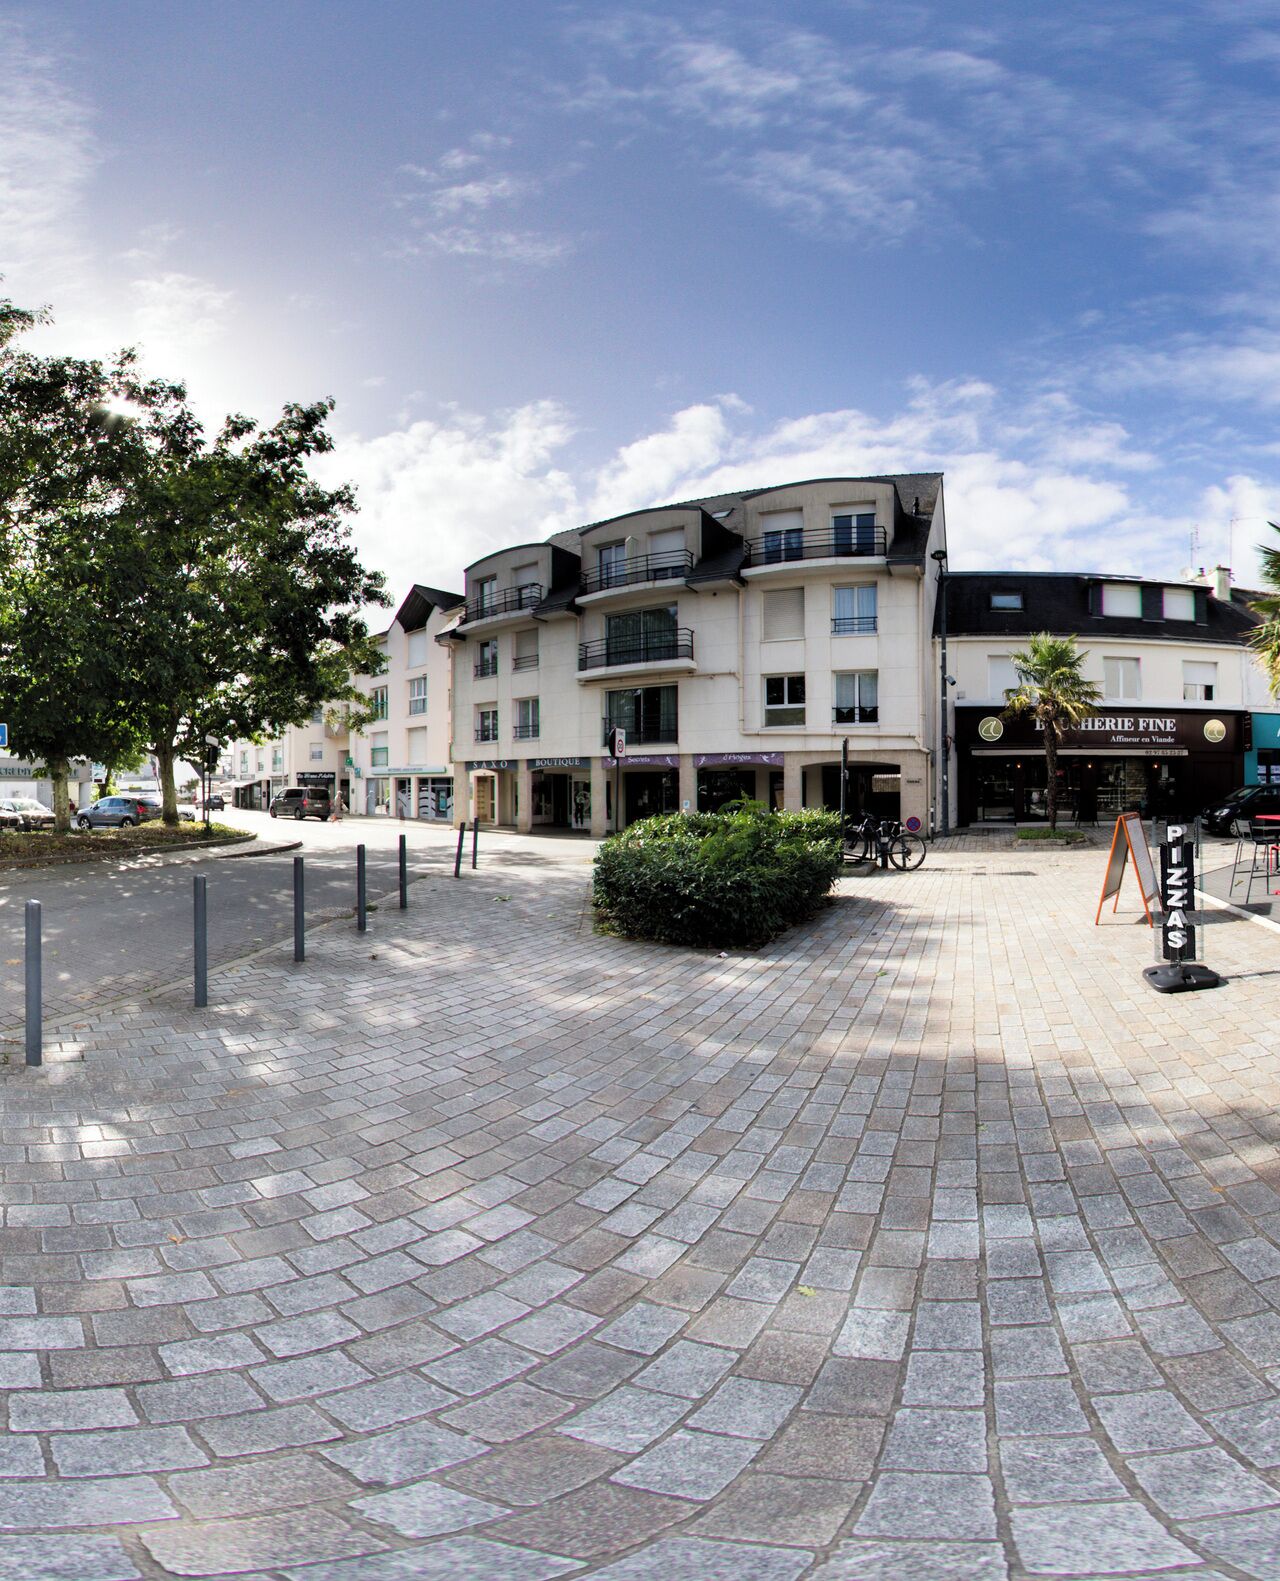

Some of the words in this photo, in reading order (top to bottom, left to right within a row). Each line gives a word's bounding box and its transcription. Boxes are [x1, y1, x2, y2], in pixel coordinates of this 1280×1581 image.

[1138, 718, 1176, 732] FINE
[1110, 735, 1140, 743] Affineur
[1151, 735, 1175, 743] Viande
[473, 760, 508, 768] SAXO
[535, 758, 581, 767] BOUTIQUE
[1166, 825, 1186, 949] PIZZAS
